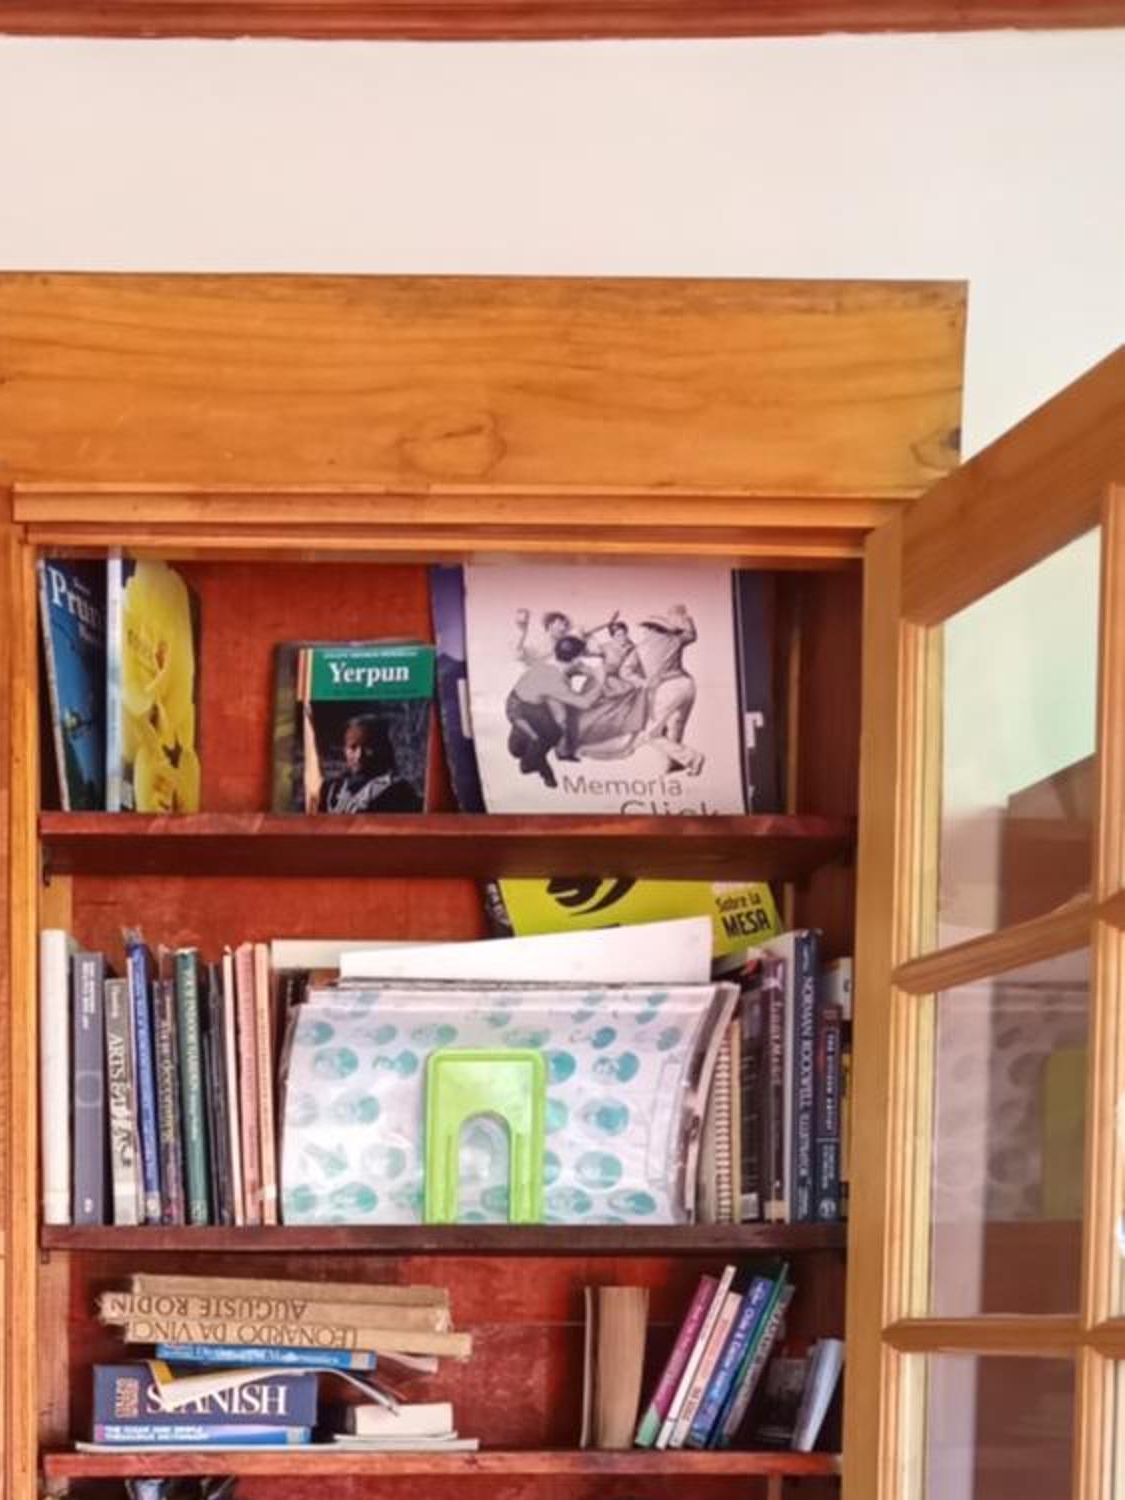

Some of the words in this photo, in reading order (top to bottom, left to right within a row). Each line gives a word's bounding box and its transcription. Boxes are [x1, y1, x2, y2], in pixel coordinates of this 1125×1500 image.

[328, 661, 410, 688] Yerpun
[562, 775, 682, 796] Memoria
[714, 896, 747, 913] Sobre
[721, 909, 772, 938] MESA
[111, 1296, 188, 1317] RODIN
[199, 1299, 308, 1320] AUGUSTE
[201, 1321, 225, 1342] DA
[237, 1322, 358, 1349] LEONARDO
[146, 1384, 288, 1415] SANISH
